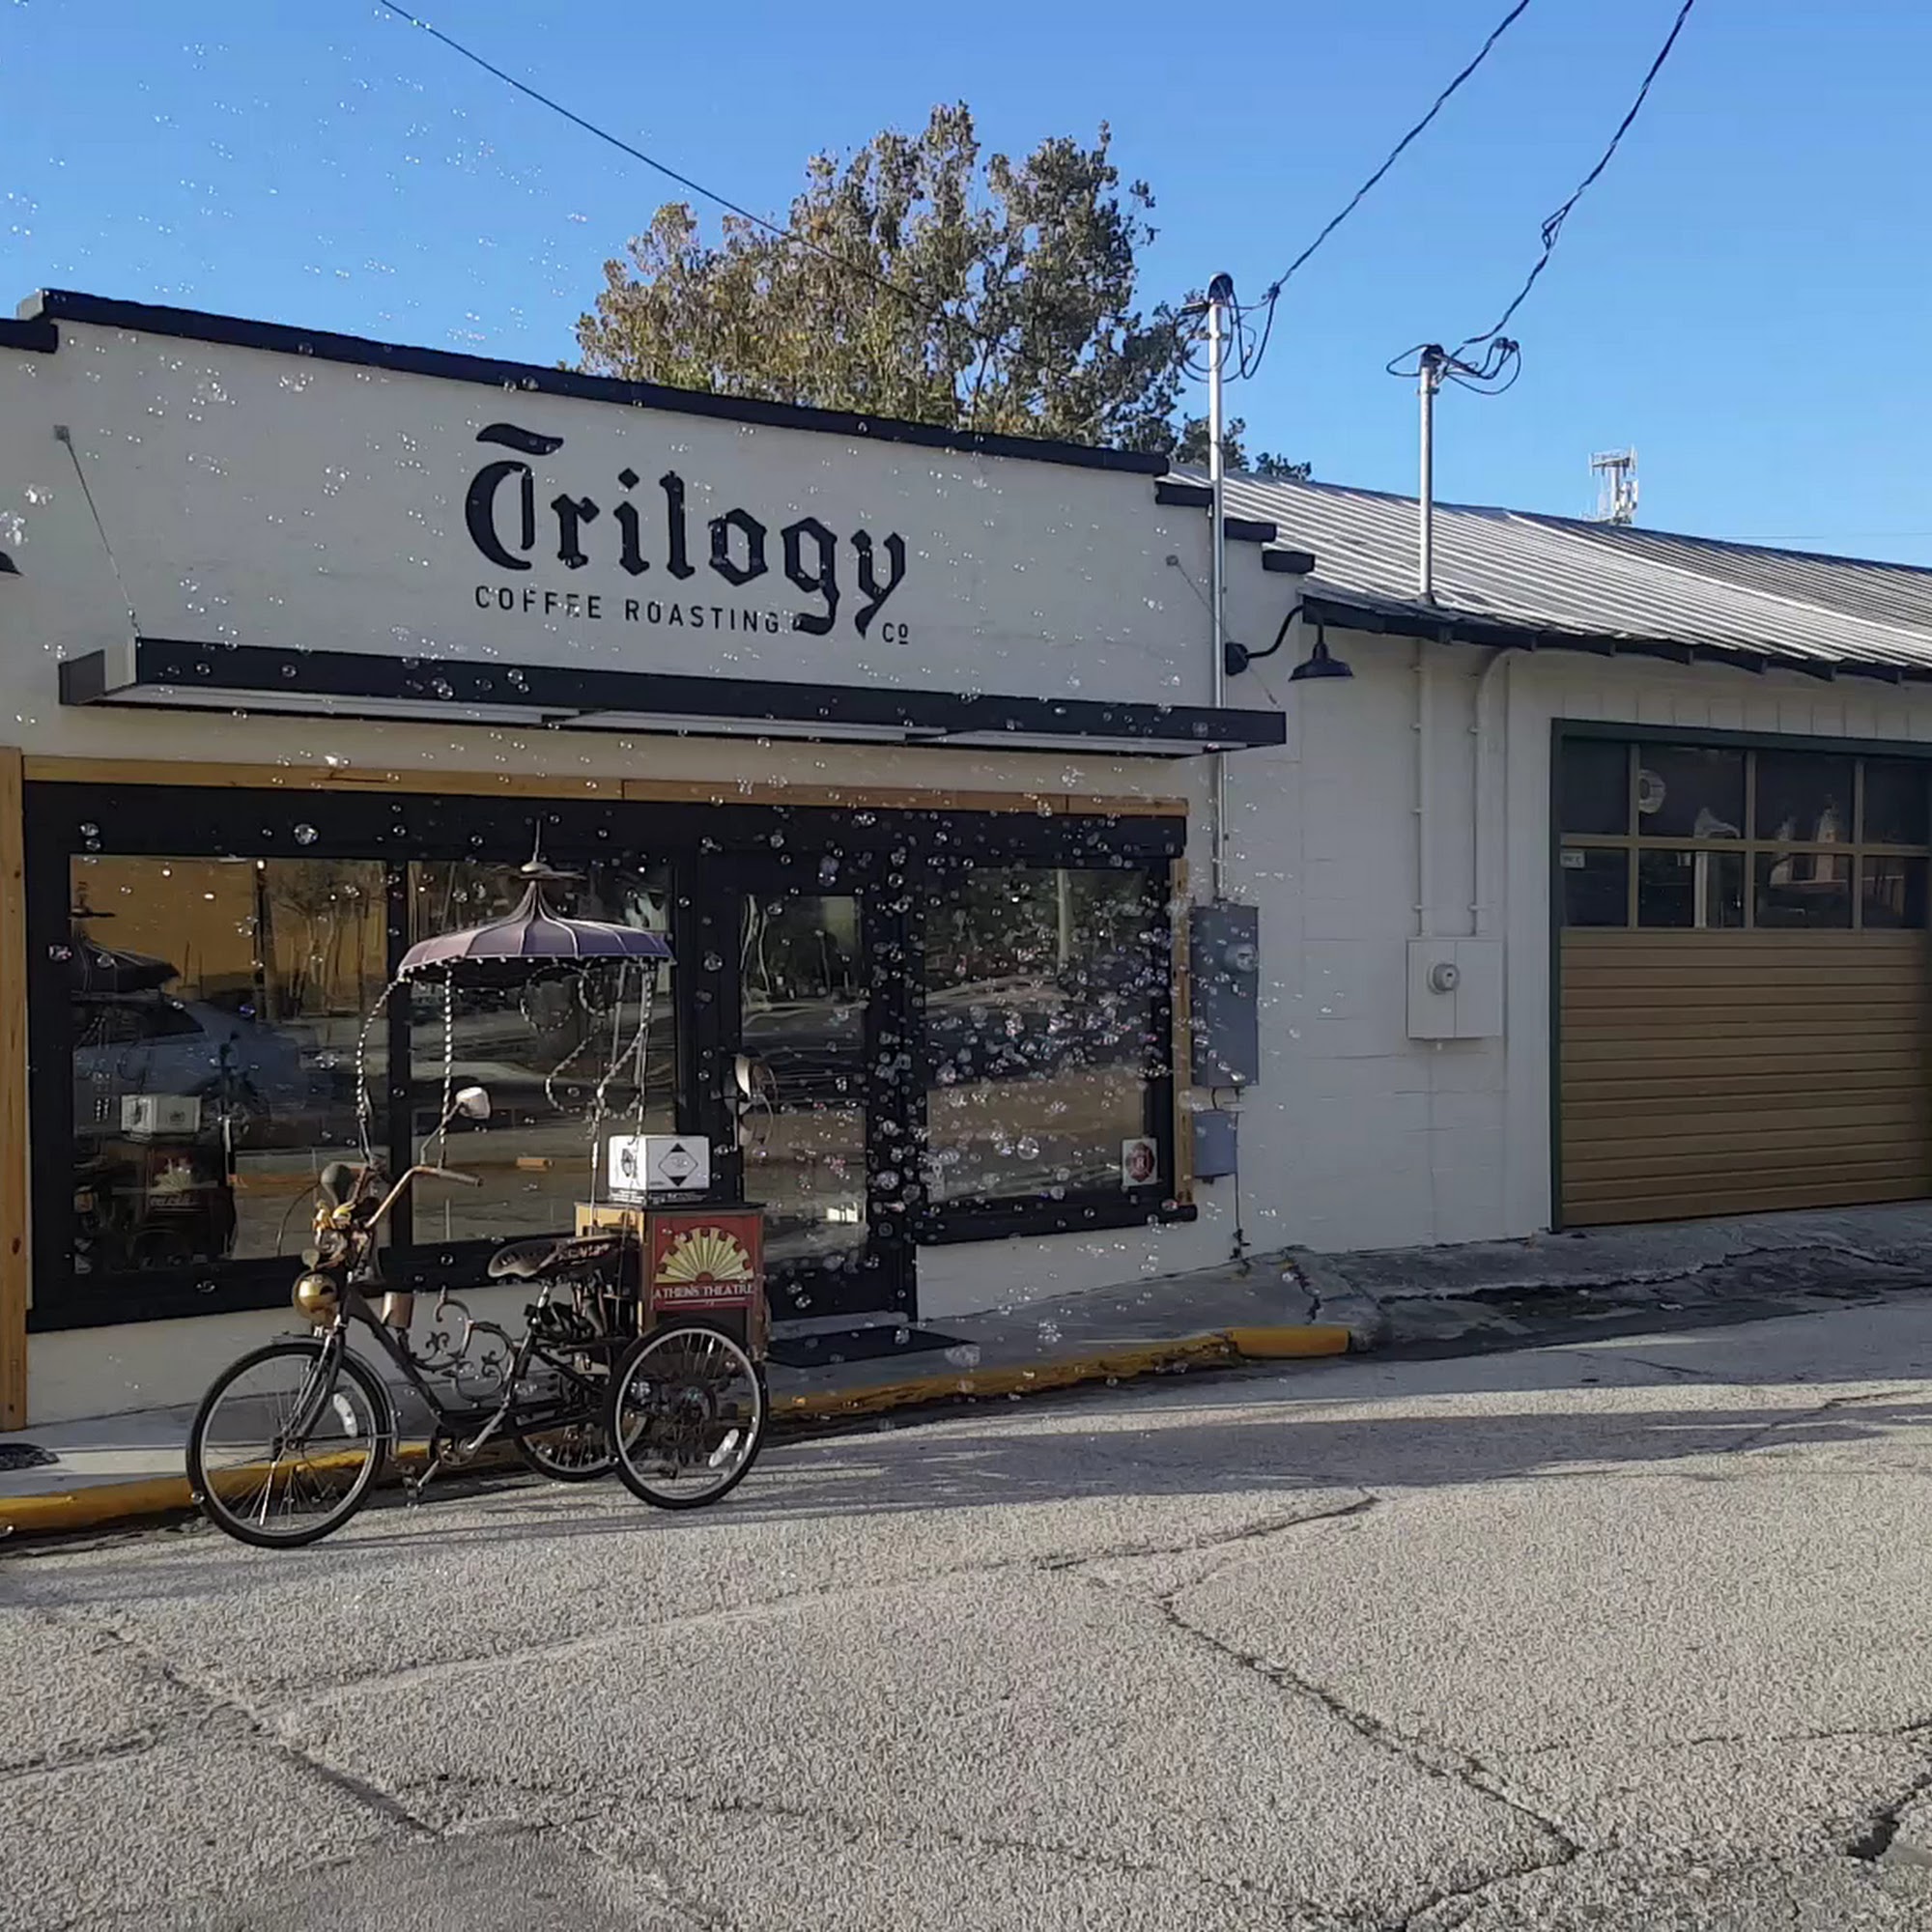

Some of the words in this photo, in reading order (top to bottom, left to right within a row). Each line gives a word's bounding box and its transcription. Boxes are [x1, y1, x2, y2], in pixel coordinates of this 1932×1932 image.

[466, 423, 906, 639] Trilogy
[474, 585, 602, 619] COFFEE
[625, 599, 780, 634] ROASTING
[701, 1283, 753, 1296] THEATRE
